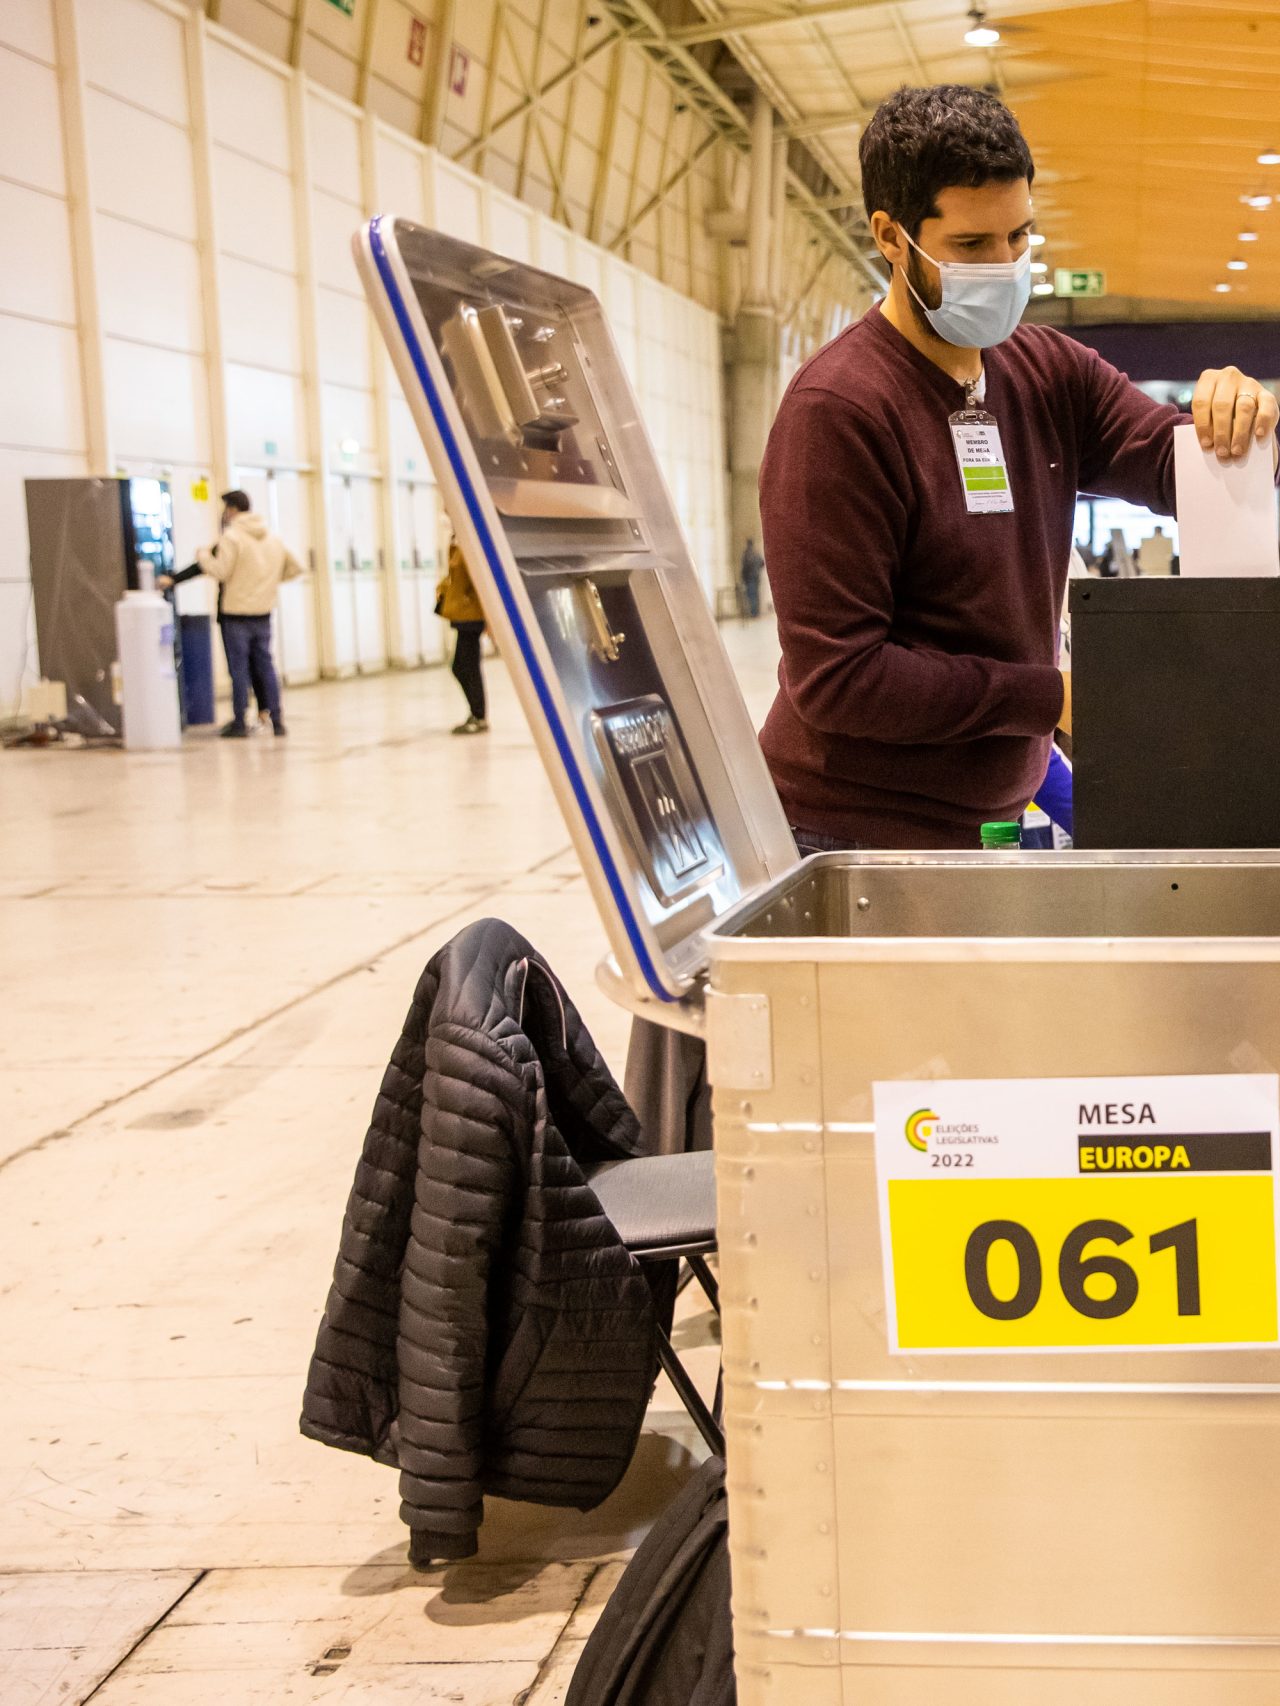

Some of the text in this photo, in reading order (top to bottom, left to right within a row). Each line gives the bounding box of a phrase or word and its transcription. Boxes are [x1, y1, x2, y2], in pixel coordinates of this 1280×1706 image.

[1078, 1102, 1157, 1125] MESA
[935, 1123, 980, 1135] ELEIÇÕES
[935, 1135, 1000, 1145] LEGISLATIVAS
[931, 1153, 975, 1168] 2022
[1079, 1145, 1191, 1170] EUROPA
[964, 1217, 1202, 1321] 061
